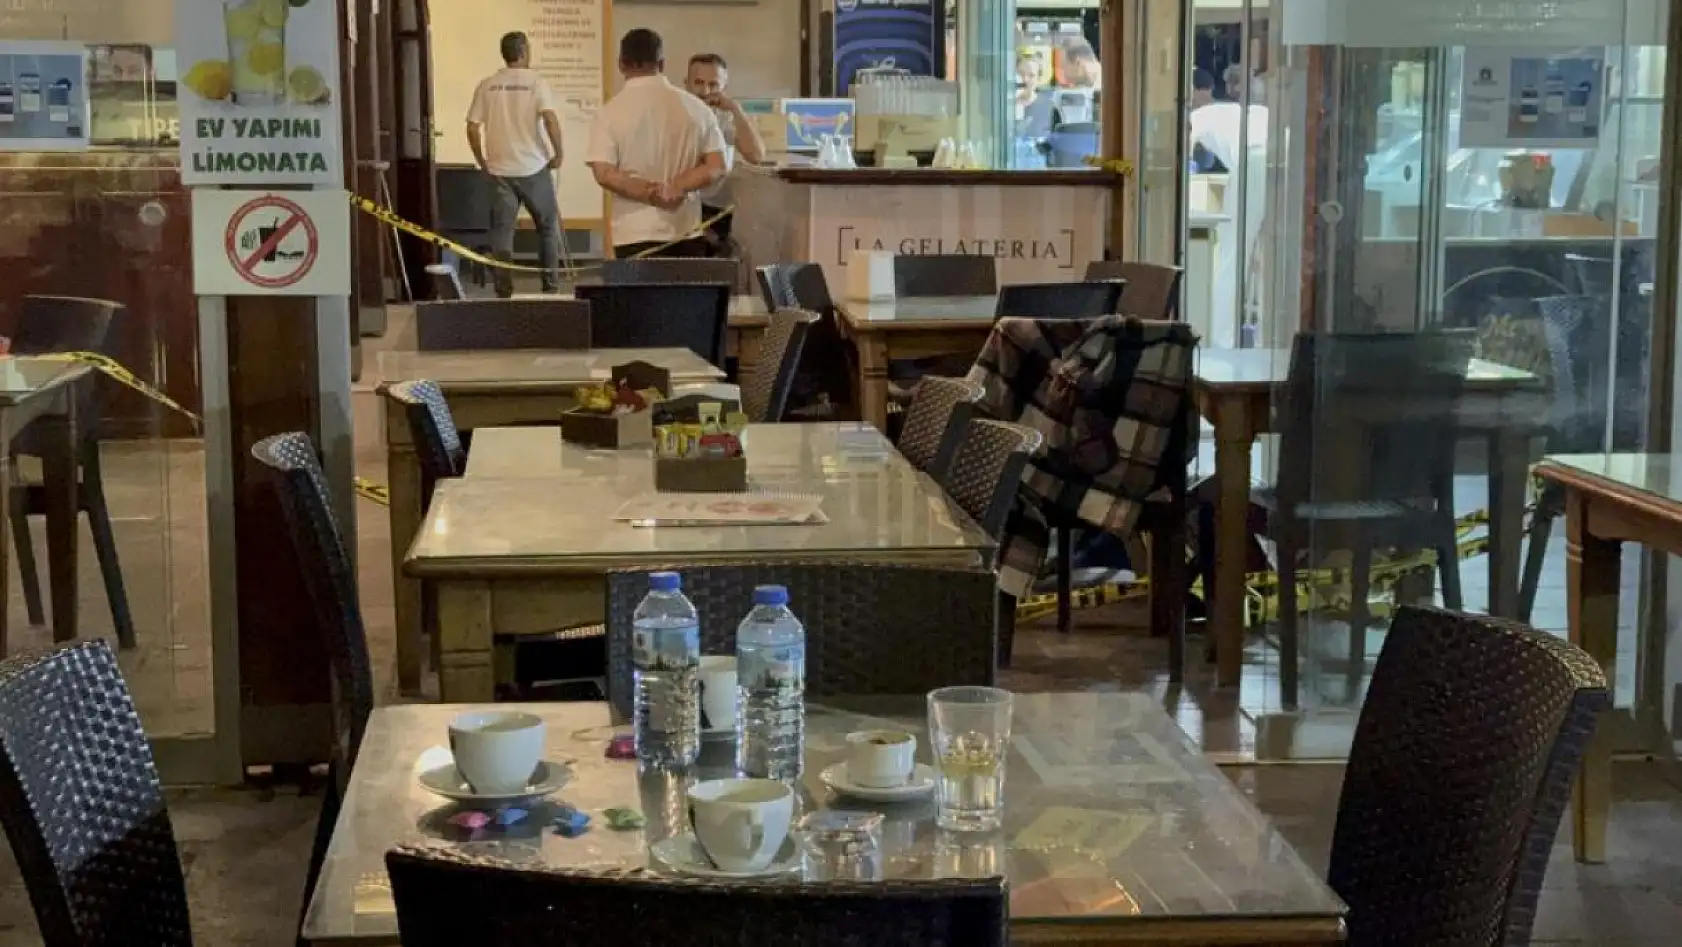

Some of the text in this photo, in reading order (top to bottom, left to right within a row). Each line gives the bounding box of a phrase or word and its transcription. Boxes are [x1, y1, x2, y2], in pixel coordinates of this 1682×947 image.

[196, 118, 321, 138] EV YAPIMI
[192, 146, 328, 172] LİMONATA
[900, 237, 1059, 259] GELATERIA
